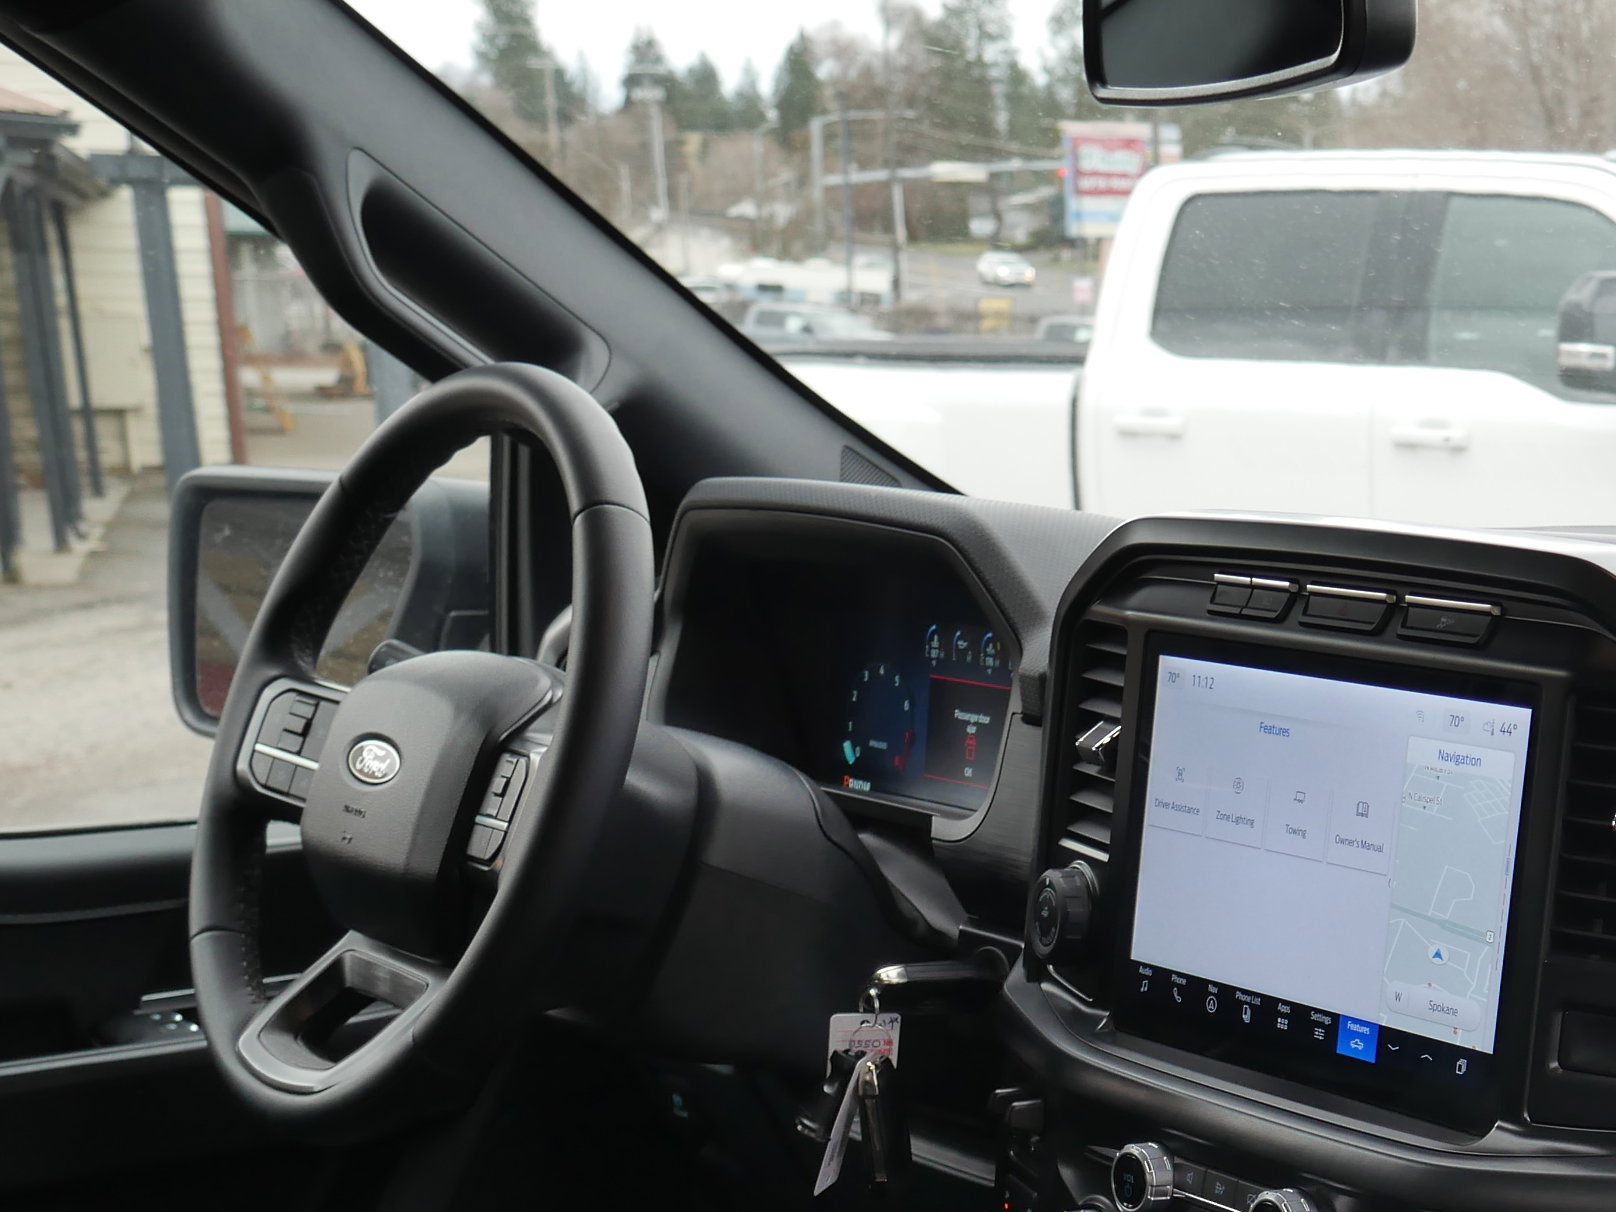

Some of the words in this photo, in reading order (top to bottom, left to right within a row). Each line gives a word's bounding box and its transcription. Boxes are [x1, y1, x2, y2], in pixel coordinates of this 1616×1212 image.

[1167, 671, 1180, 684] 70°
[1191, 674, 1214, 690] 11:12
[1258, 721, 1291, 739] Features
[1449, 714, 1465, 728] 70°
[1499, 721, 1518, 736] 44°
[357, 745, 392, 780] Ford
[1437, 748, 1483, 768] Navigation
[1154, 797, 1170, 810] Driver
[1170, 800, 1200, 816] Assistance
[1215, 809, 1231, 822] Zone
[1231, 812, 1256, 829] Lighting
[1285, 823, 1307, 839] Towing
[1334, 833, 1360, 849] Owner's
[1360, 838, 1384, 854] Manual
[1138, 965, 1153, 977] Audio
[1171, 973, 1187, 986] Phone
[1207, 983, 1219, 994] Nav
[1235, 990, 1251, 1003] Phone
[1251, 994, 1261, 1006] List
[1395, 991, 1403, 1003] W
[1428, 999, 1459, 1017] Spokane
[1277, 1002, 1291, 1014] Apps
[1310, 1010, 1332, 1025] Settings
[1347, 1020, 1370, 1035] Features
